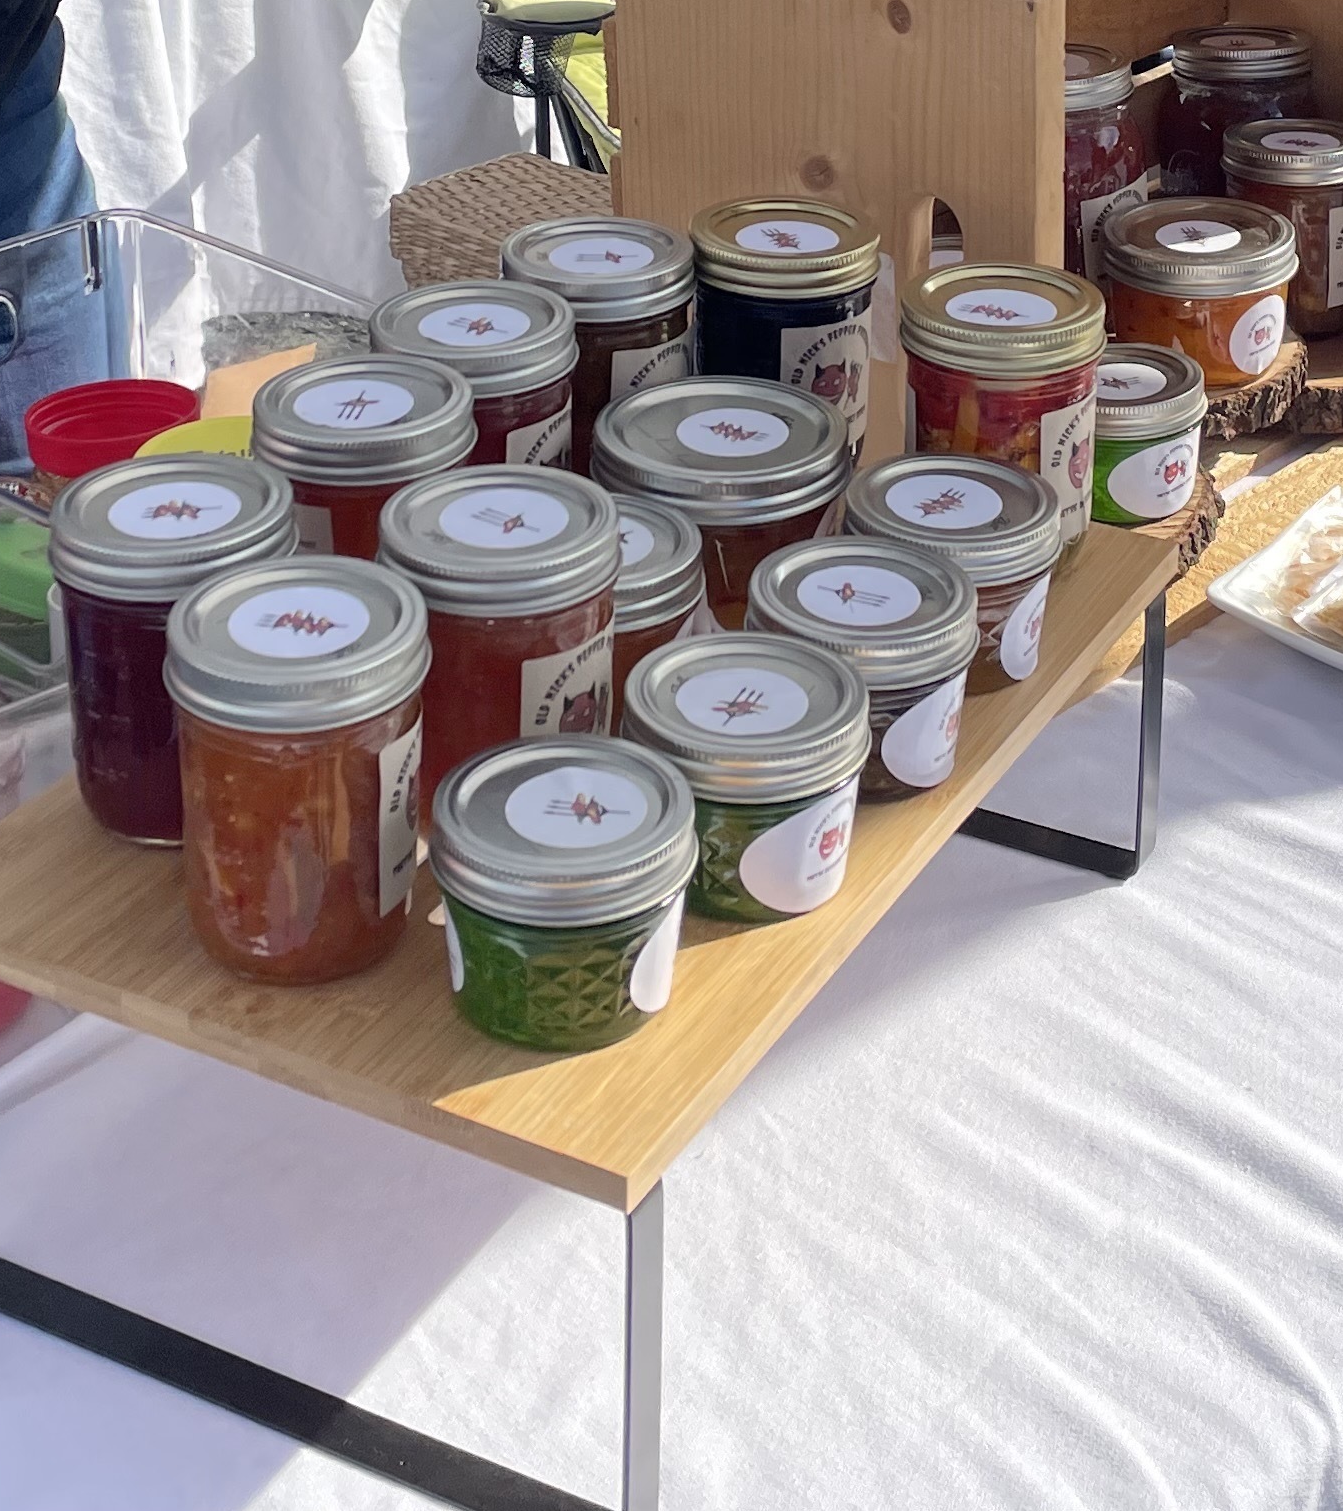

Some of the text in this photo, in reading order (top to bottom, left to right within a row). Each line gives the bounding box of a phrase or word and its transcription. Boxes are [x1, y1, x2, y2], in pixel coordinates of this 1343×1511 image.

[791, 368, 803, 385] OLD
[1051, 449, 1062, 468] OLD
[535, 704, 550, 725] OLD
